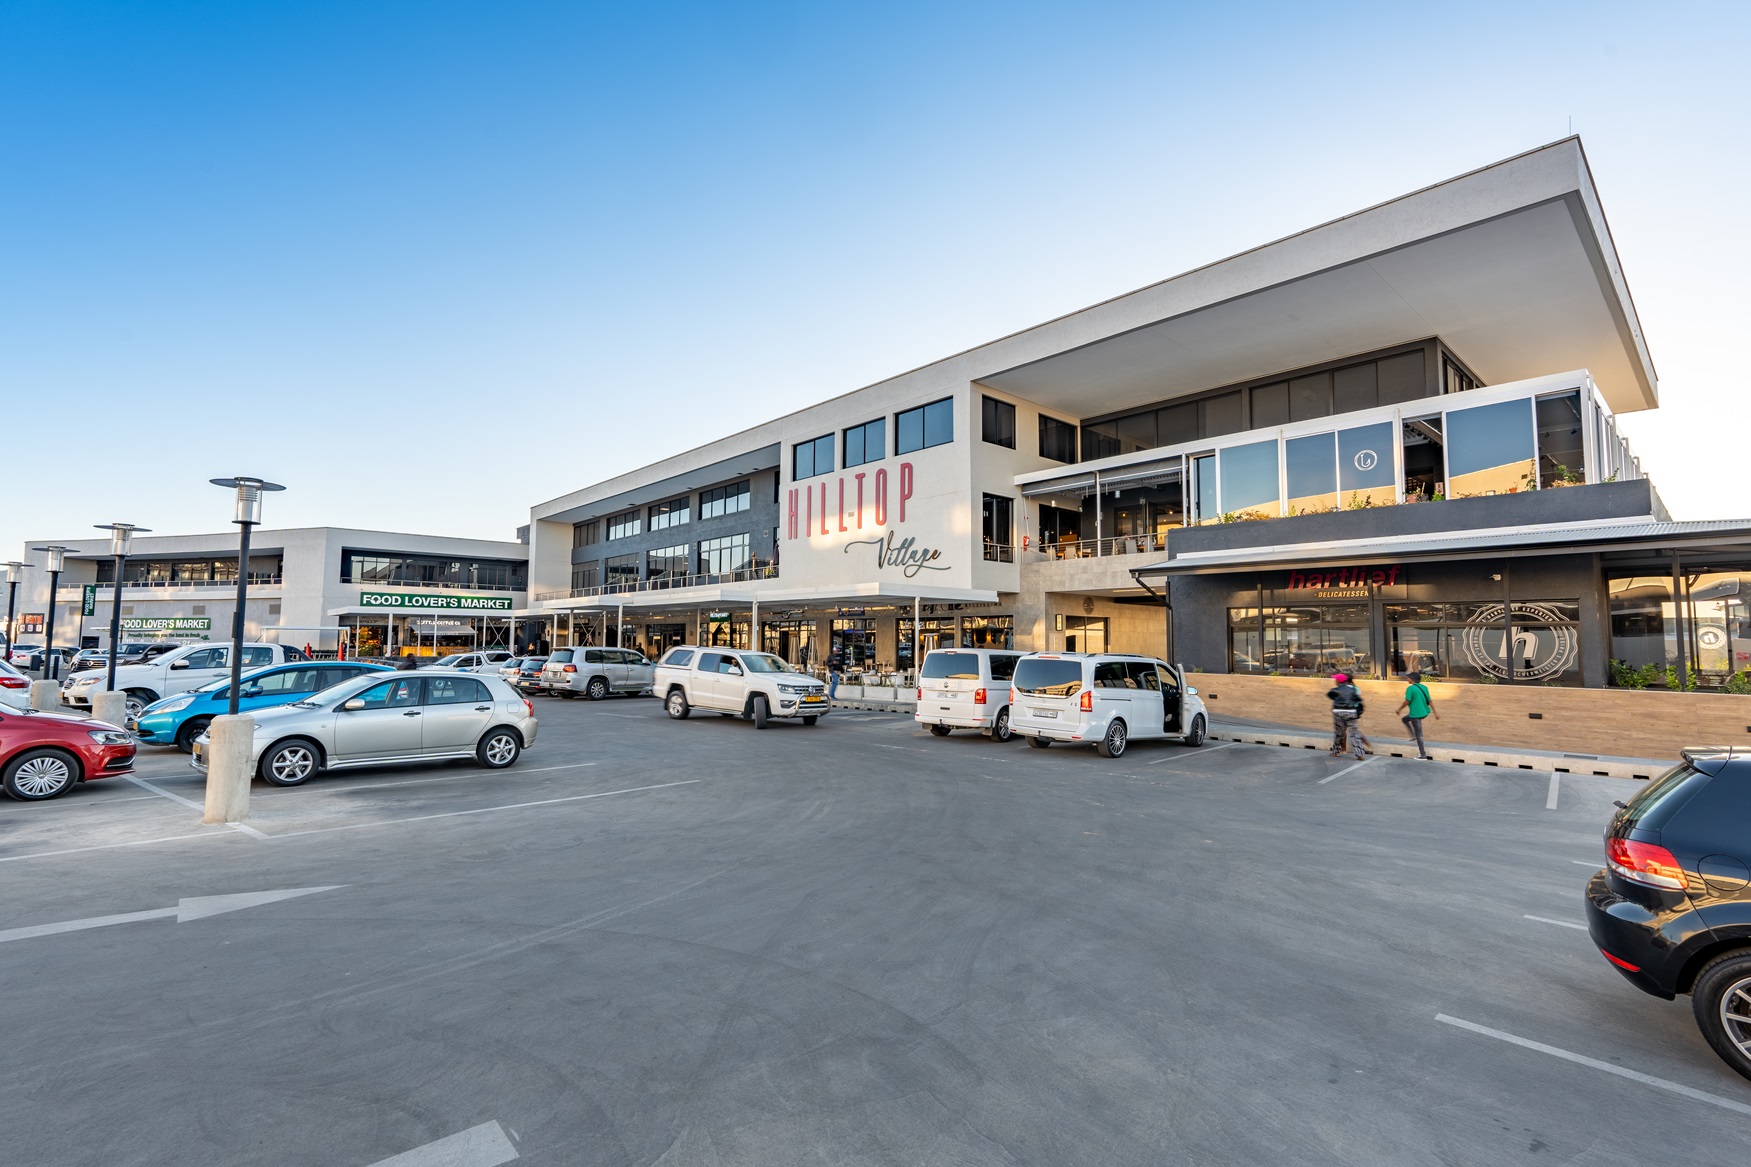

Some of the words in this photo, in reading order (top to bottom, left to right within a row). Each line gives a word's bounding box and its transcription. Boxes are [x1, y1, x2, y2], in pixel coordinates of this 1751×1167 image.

[788, 461, 914, 541] HILLTOP
[844, 530, 952, 578] Village
[1288, 565, 1401, 590] hartlief
[363, 594, 401, 605] FOOD
[405, 596, 458, 608] LOVER'S
[461, 598, 510, 609] MARKET
[1318, 590, 1370, 598] DELICATESSEN
[123, 619, 141, 628] OOD
[142, 619, 174, 629] LOVER'S
[176, 619, 209, 629] MARKET
